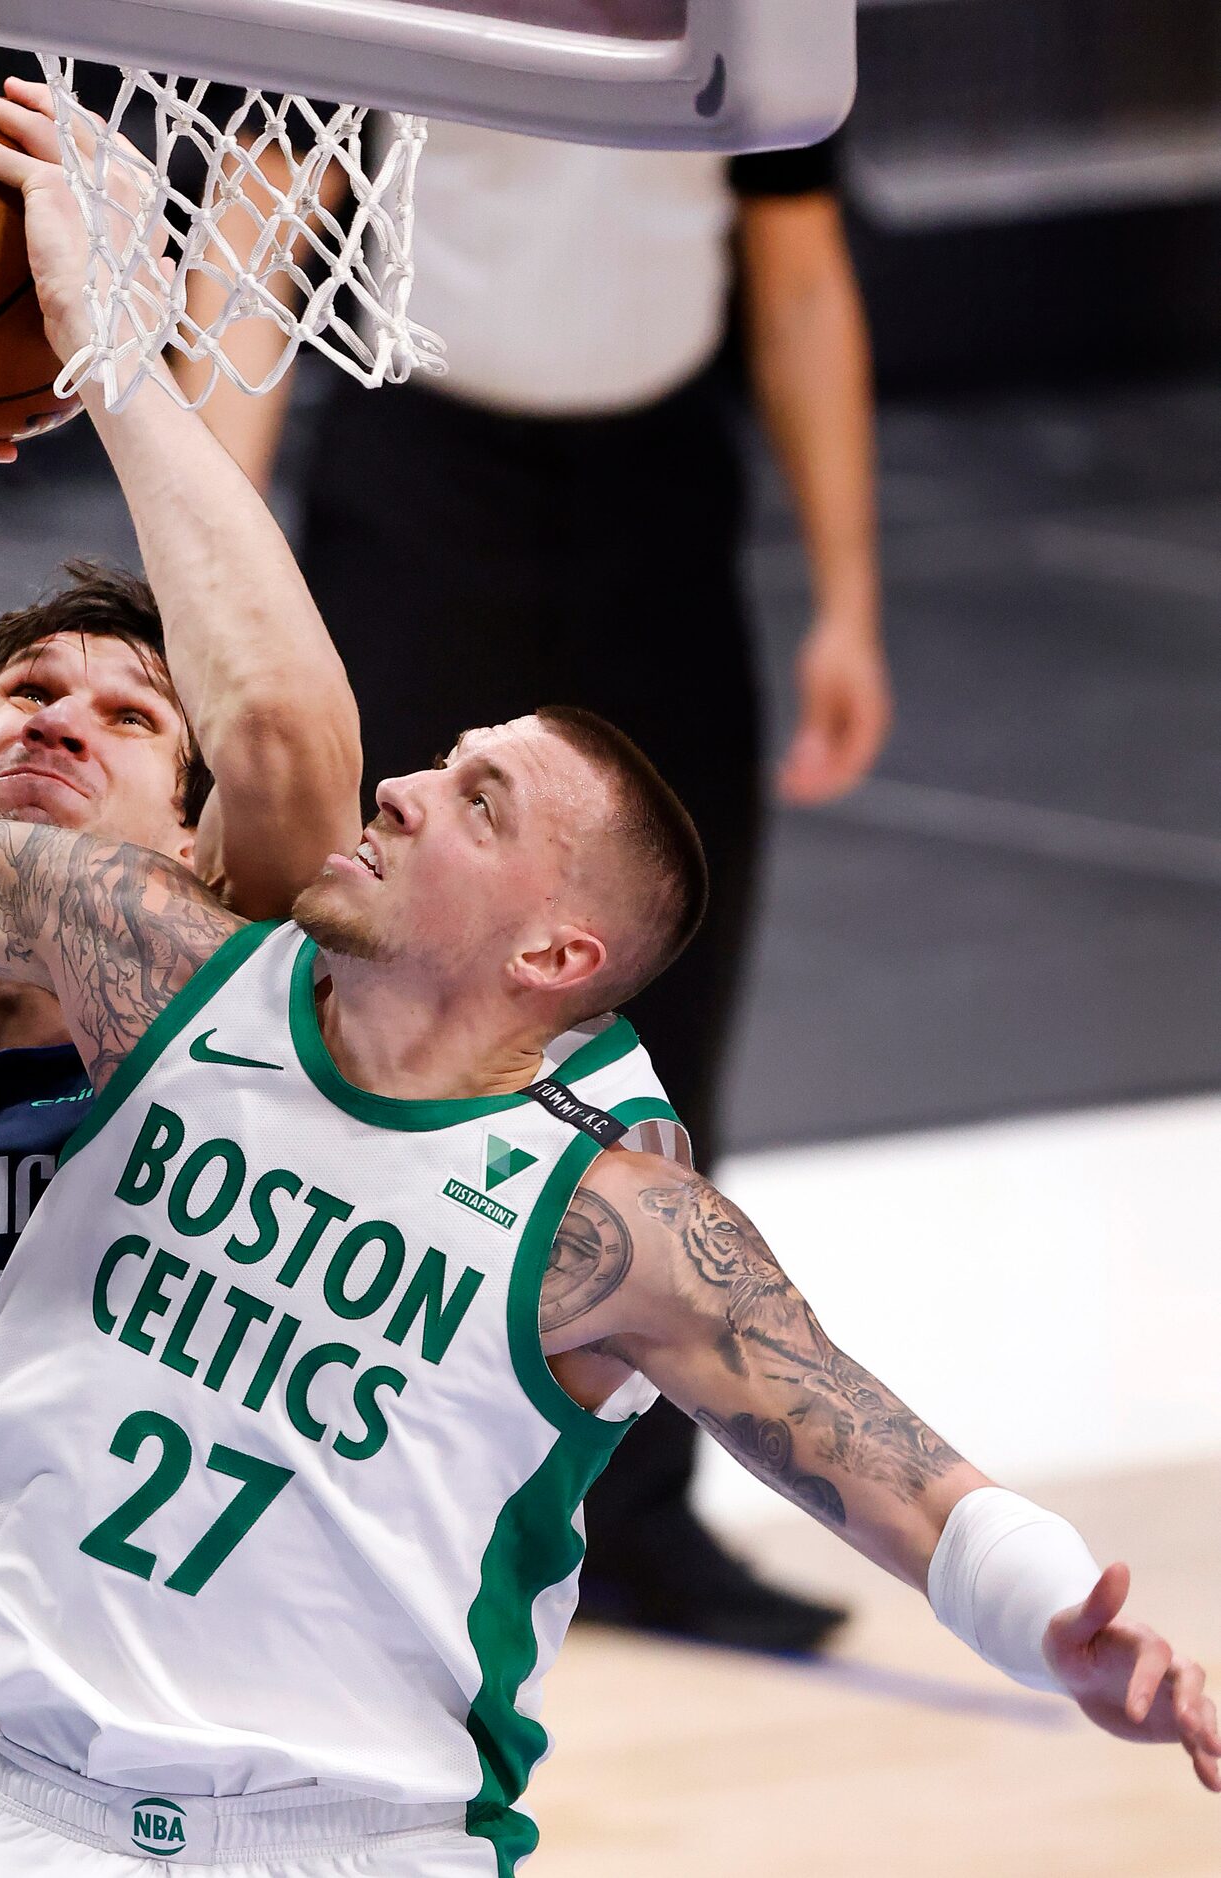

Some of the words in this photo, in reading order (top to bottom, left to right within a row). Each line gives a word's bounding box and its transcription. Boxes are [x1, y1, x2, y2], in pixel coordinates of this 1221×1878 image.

[534, 1083, 581, 1119] TOMMY
[115, 1102, 485, 1365] BOSTON
[447, 1181, 515, 1229] VISTAPRINT
[92, 1234, 408, 1461] CELTICS
[79, 1410, 296, 1597] 27
[133, 1811, 186, 1842] NBA
